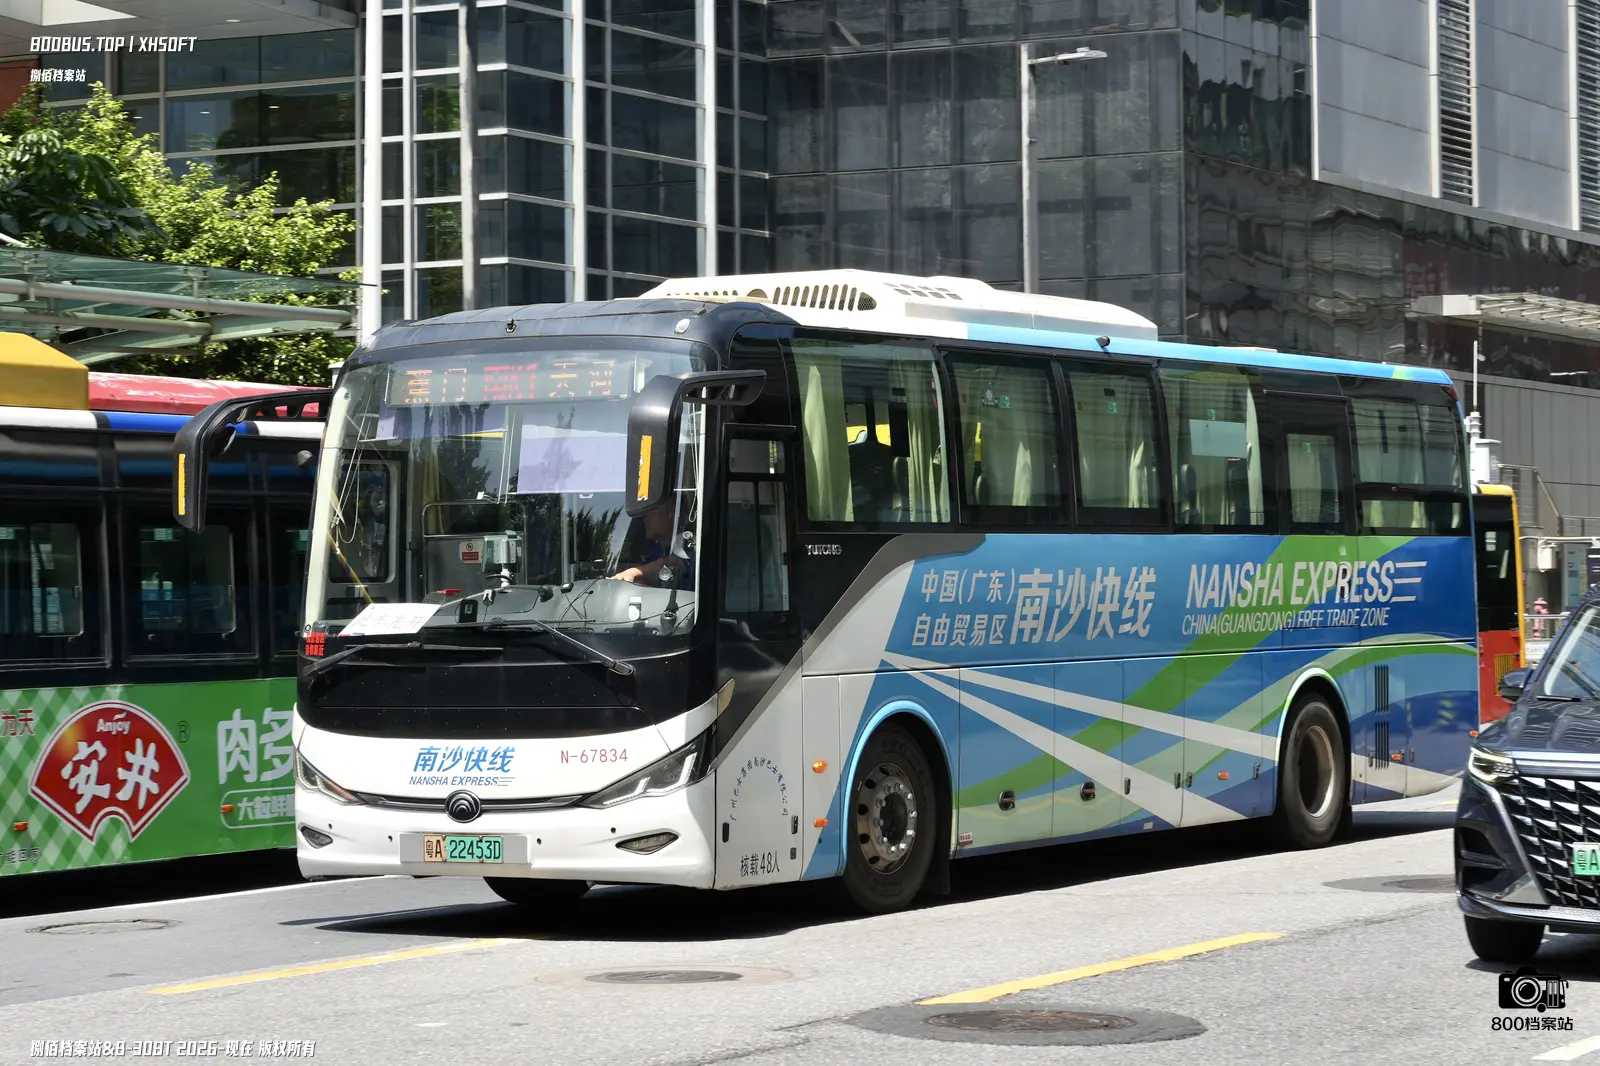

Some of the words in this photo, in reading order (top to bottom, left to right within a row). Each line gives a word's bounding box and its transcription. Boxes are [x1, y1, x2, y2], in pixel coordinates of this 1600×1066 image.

[804, 544, 843, 556] YUTONG
[1185, 561, 1284, 609] NANSHA
[1290, 559, 1396, 606] EXPRESS
[1009, 566, 1157, 645] 南沙快线
[1327, 607, 1360, 628] TRADE
[1360, 606, 1391, 626] ZONE
[911, 612, 1006, 647] 自由贸易区
[96, 716, 131, 735] Anjoy
[413, 746, 516, 773] 南沙快线
[560, 748, 629, 764] N-67834
[60, 737, 161, 815] 安井
[408, 776, 449, 786] NANSHA
[450, 775, 500, 787] EXPRESS
[740, 850, 780, 878] 核载48人
